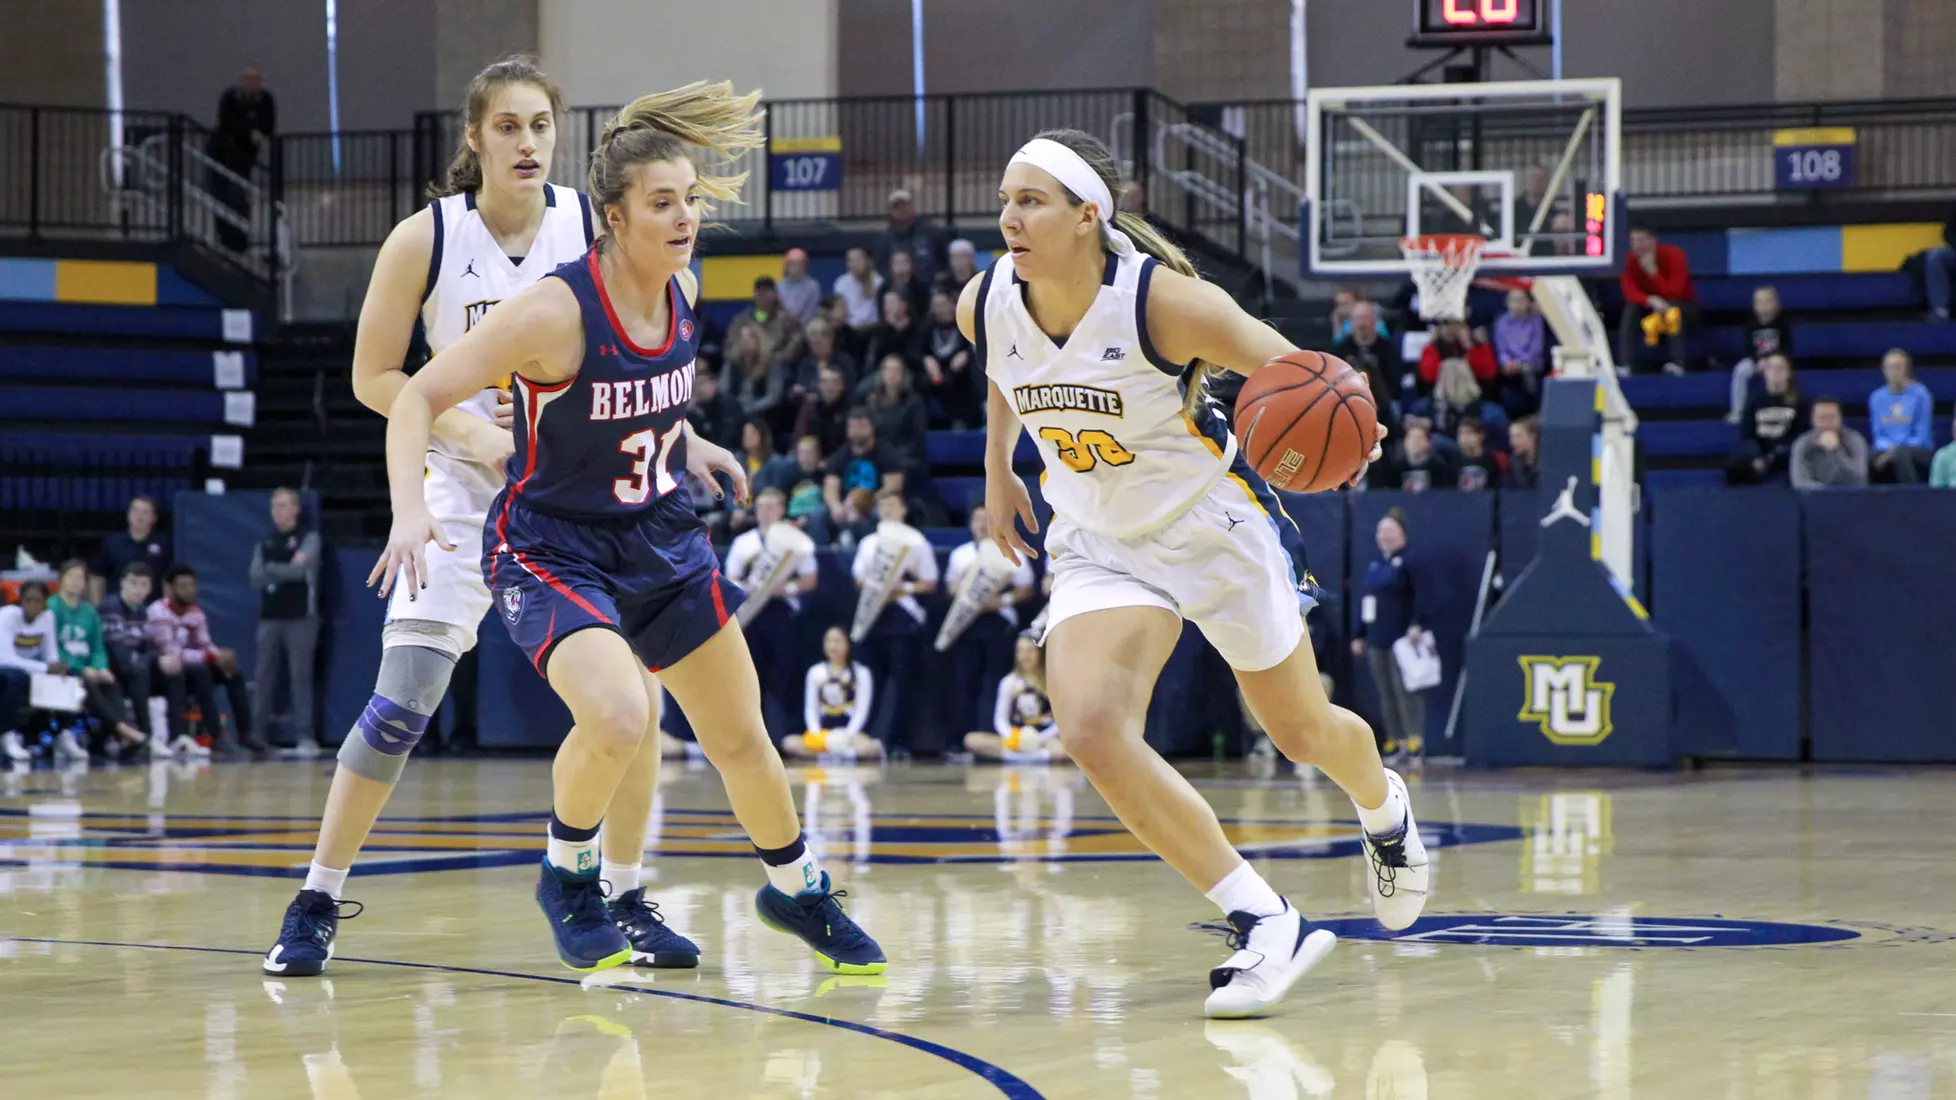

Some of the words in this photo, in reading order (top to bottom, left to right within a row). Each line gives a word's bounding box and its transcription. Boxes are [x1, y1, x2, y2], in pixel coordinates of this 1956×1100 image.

[782, 156, 827, 187] 107
[1787, 149, 1842, 182] 108
[1014, 384, 1122, 416] MARQUETTE
[1523, 659, 1609, 740] MU
